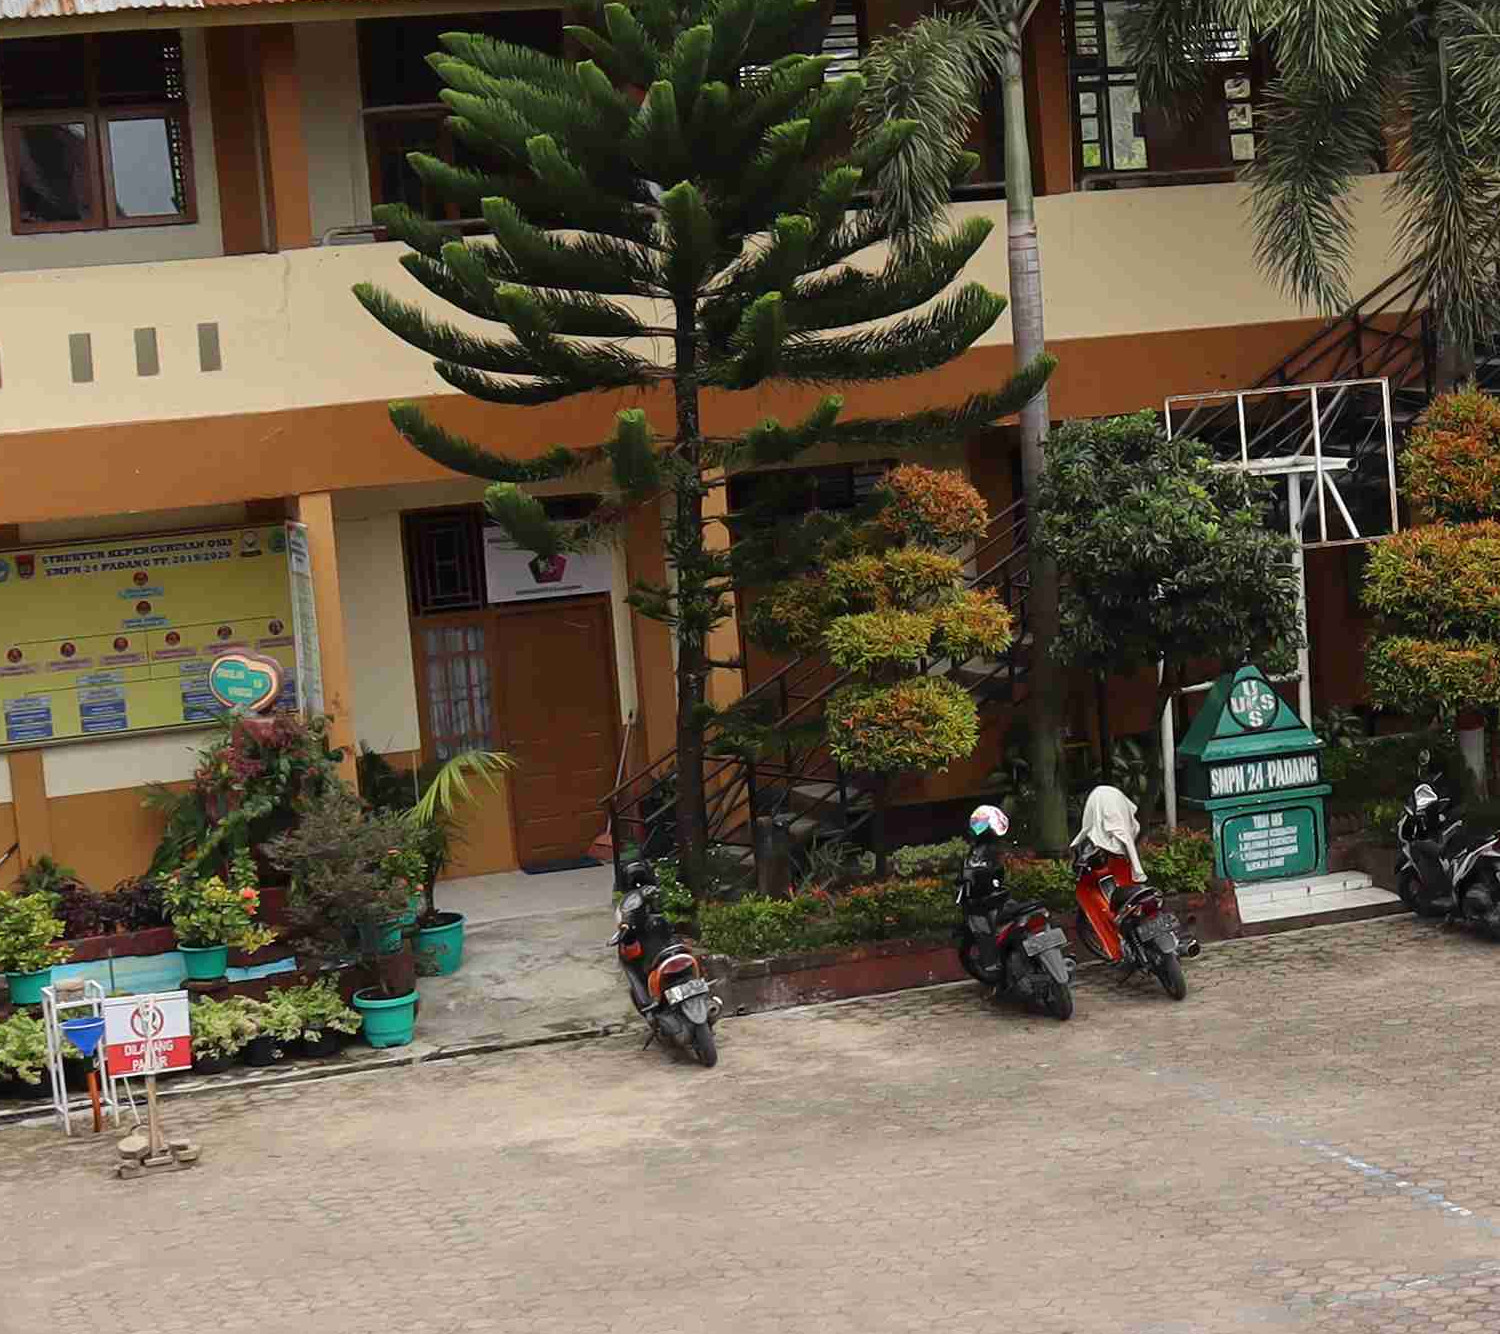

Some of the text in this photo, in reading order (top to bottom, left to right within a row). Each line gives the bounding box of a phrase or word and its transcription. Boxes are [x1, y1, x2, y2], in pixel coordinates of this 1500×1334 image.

[1211, 755, 1319, 796] SMPN 24 PADANG
